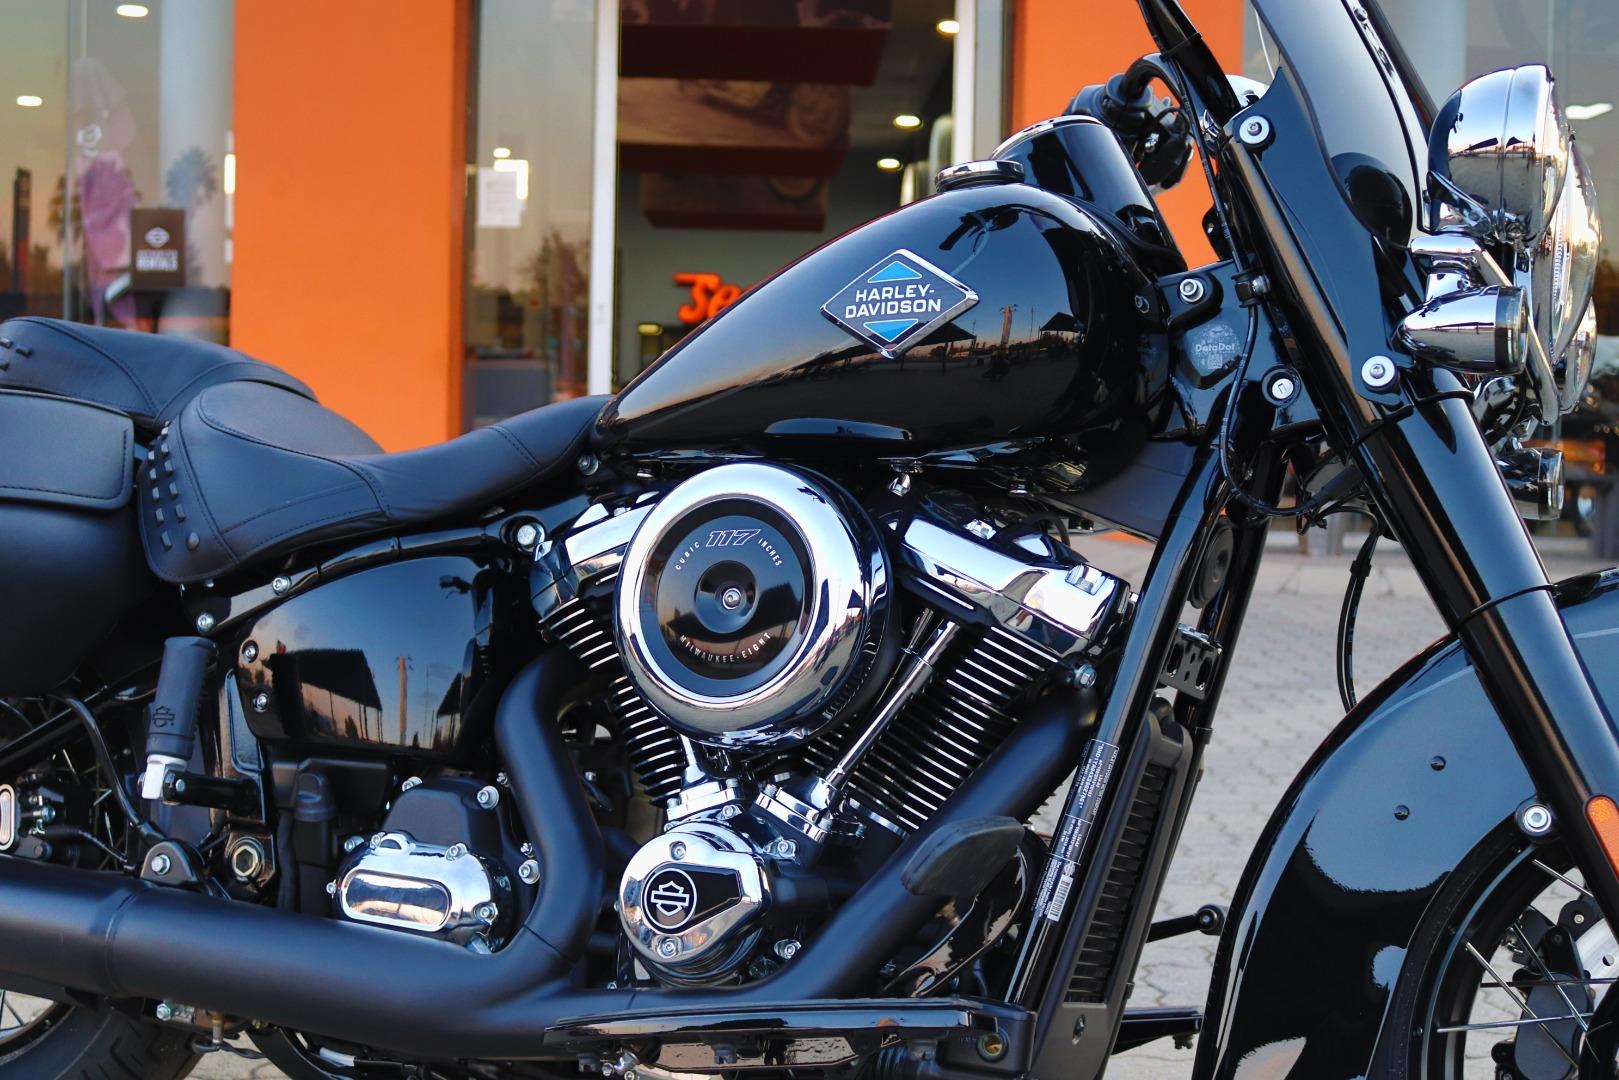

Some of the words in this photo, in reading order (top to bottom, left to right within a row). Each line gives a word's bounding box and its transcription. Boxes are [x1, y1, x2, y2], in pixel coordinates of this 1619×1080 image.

[855, 283, 935, 303] HARLEY-
[845, 298, 941, 319] DAVIDSON
[675, 541, 700, 570] CUBIC
[706, 529, 761, 547] 117
[758, 538, 783, 566] INCHES
